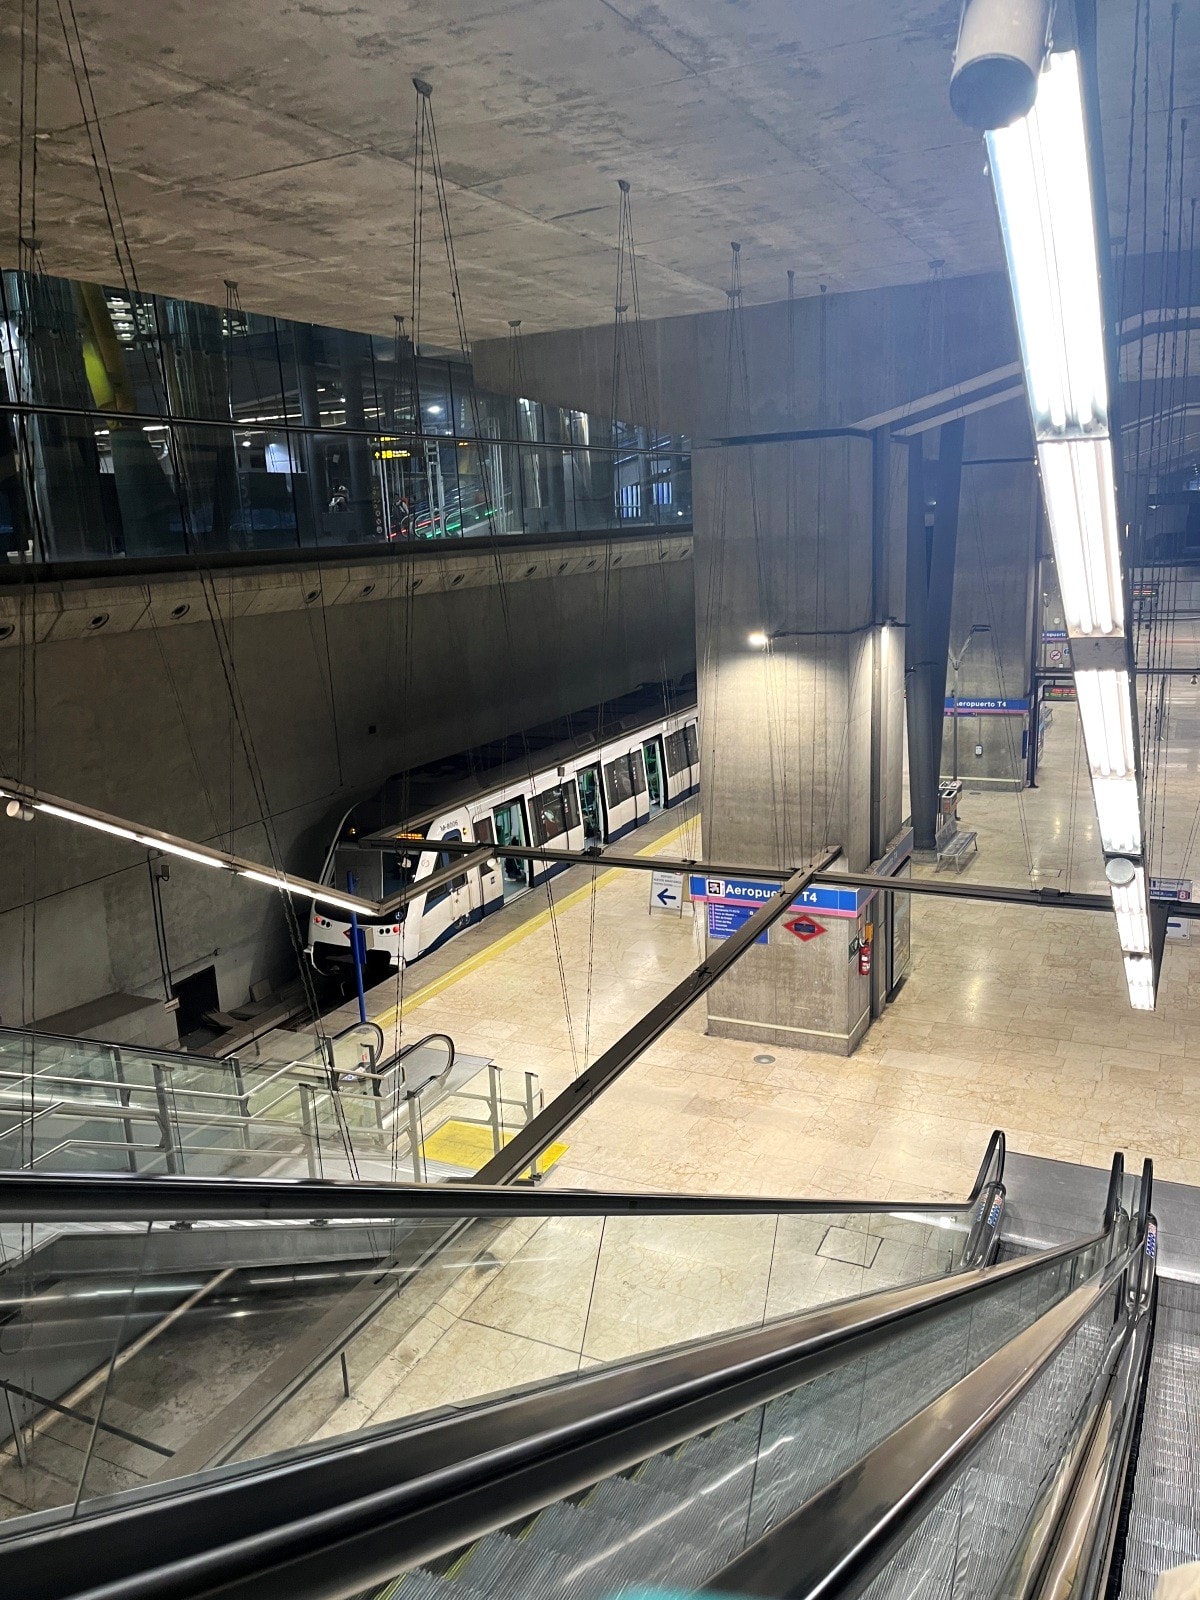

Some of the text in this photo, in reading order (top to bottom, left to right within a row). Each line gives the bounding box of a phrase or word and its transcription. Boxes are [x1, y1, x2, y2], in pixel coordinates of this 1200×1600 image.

[955, 700, 995, 708] eropuerto
[726, 884, 818, 903] Aeropu T4
[1179, 891, 1186, 899] 8
